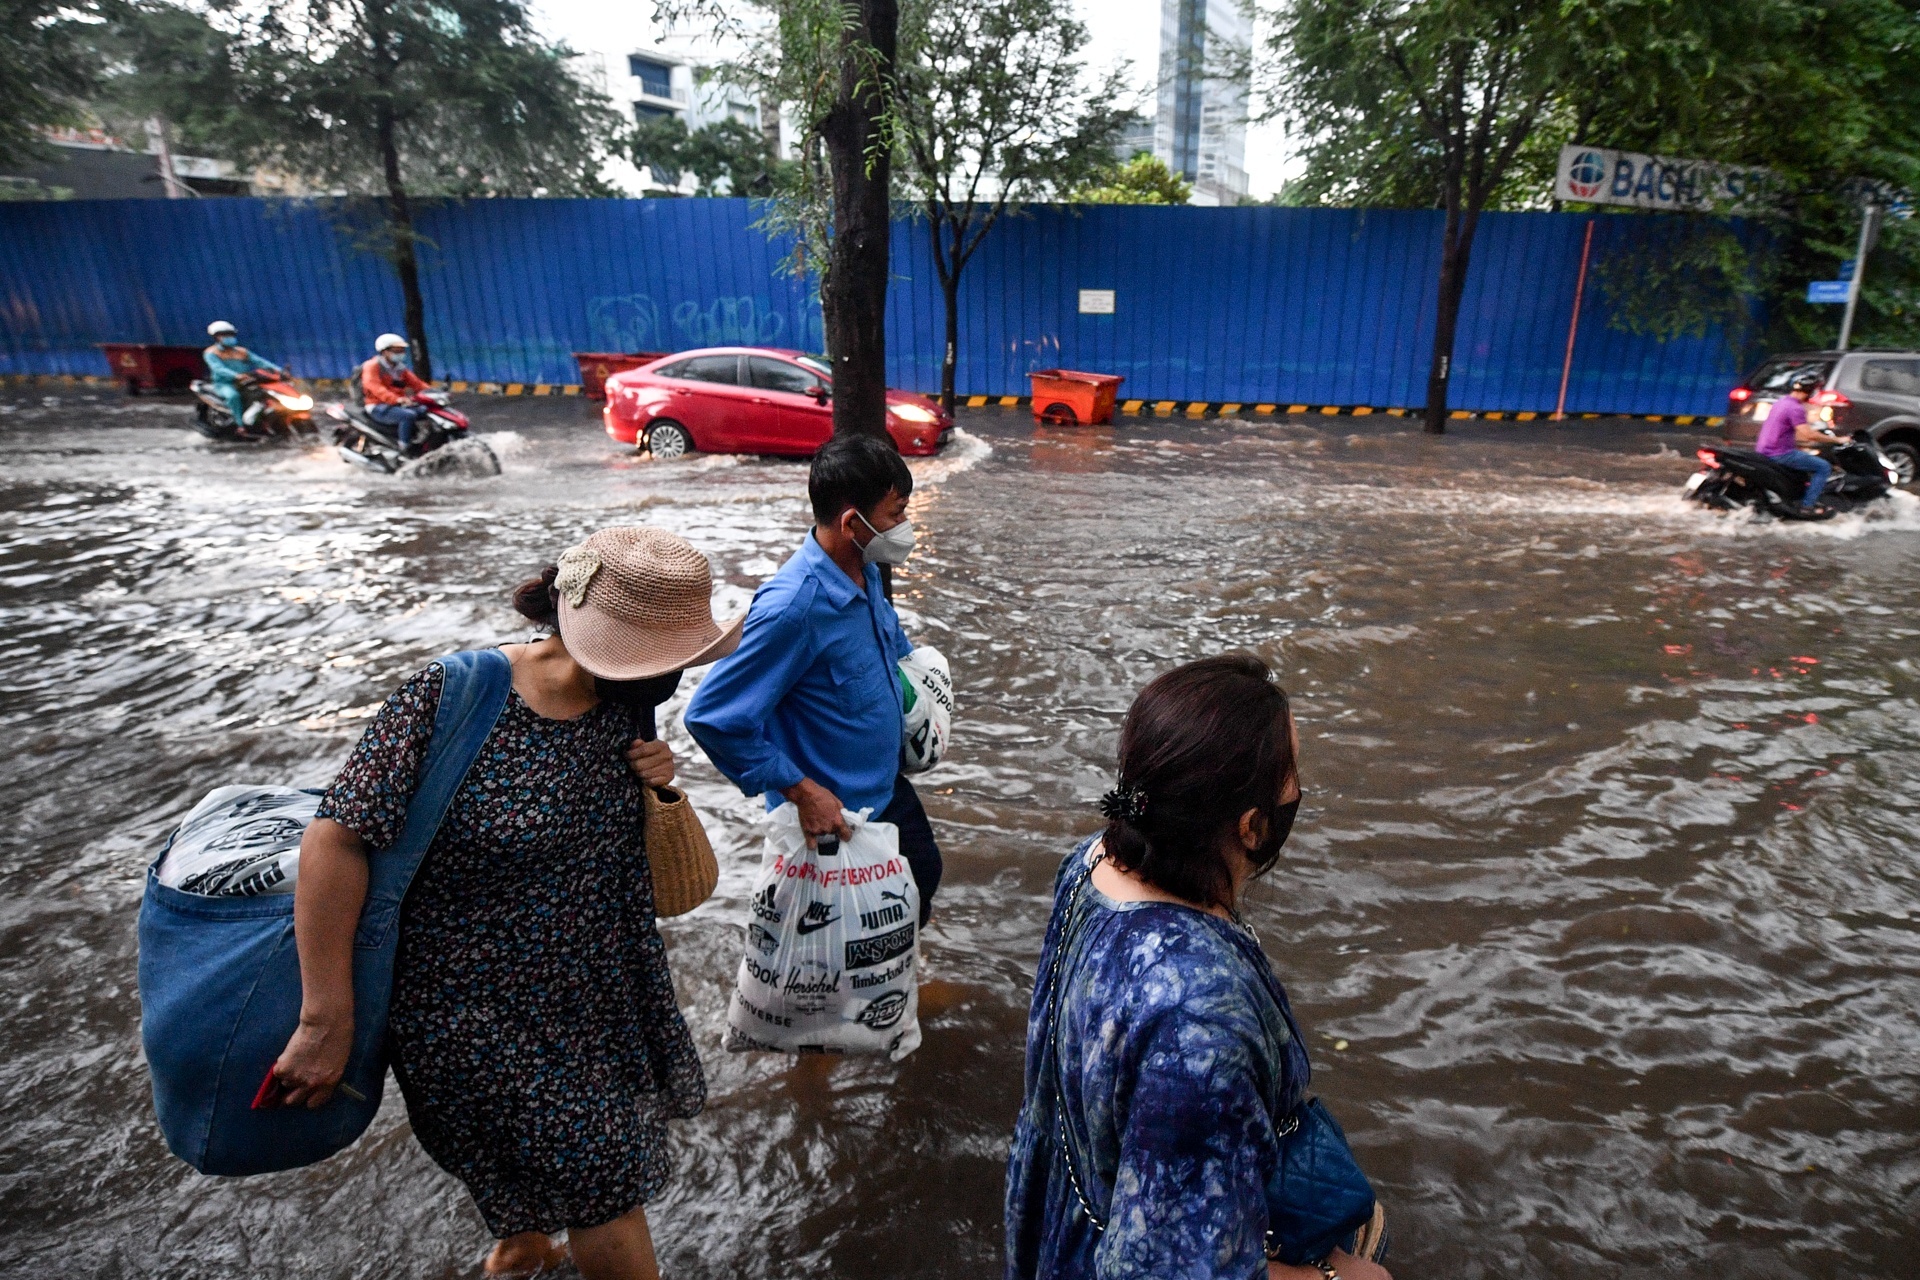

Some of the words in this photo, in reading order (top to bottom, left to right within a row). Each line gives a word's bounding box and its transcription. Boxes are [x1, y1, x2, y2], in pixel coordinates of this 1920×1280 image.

[929, 667, 951, 689] Wear
[783, 966, 840, 996] Herschel
[850, 960, 904, 990] Timberland
